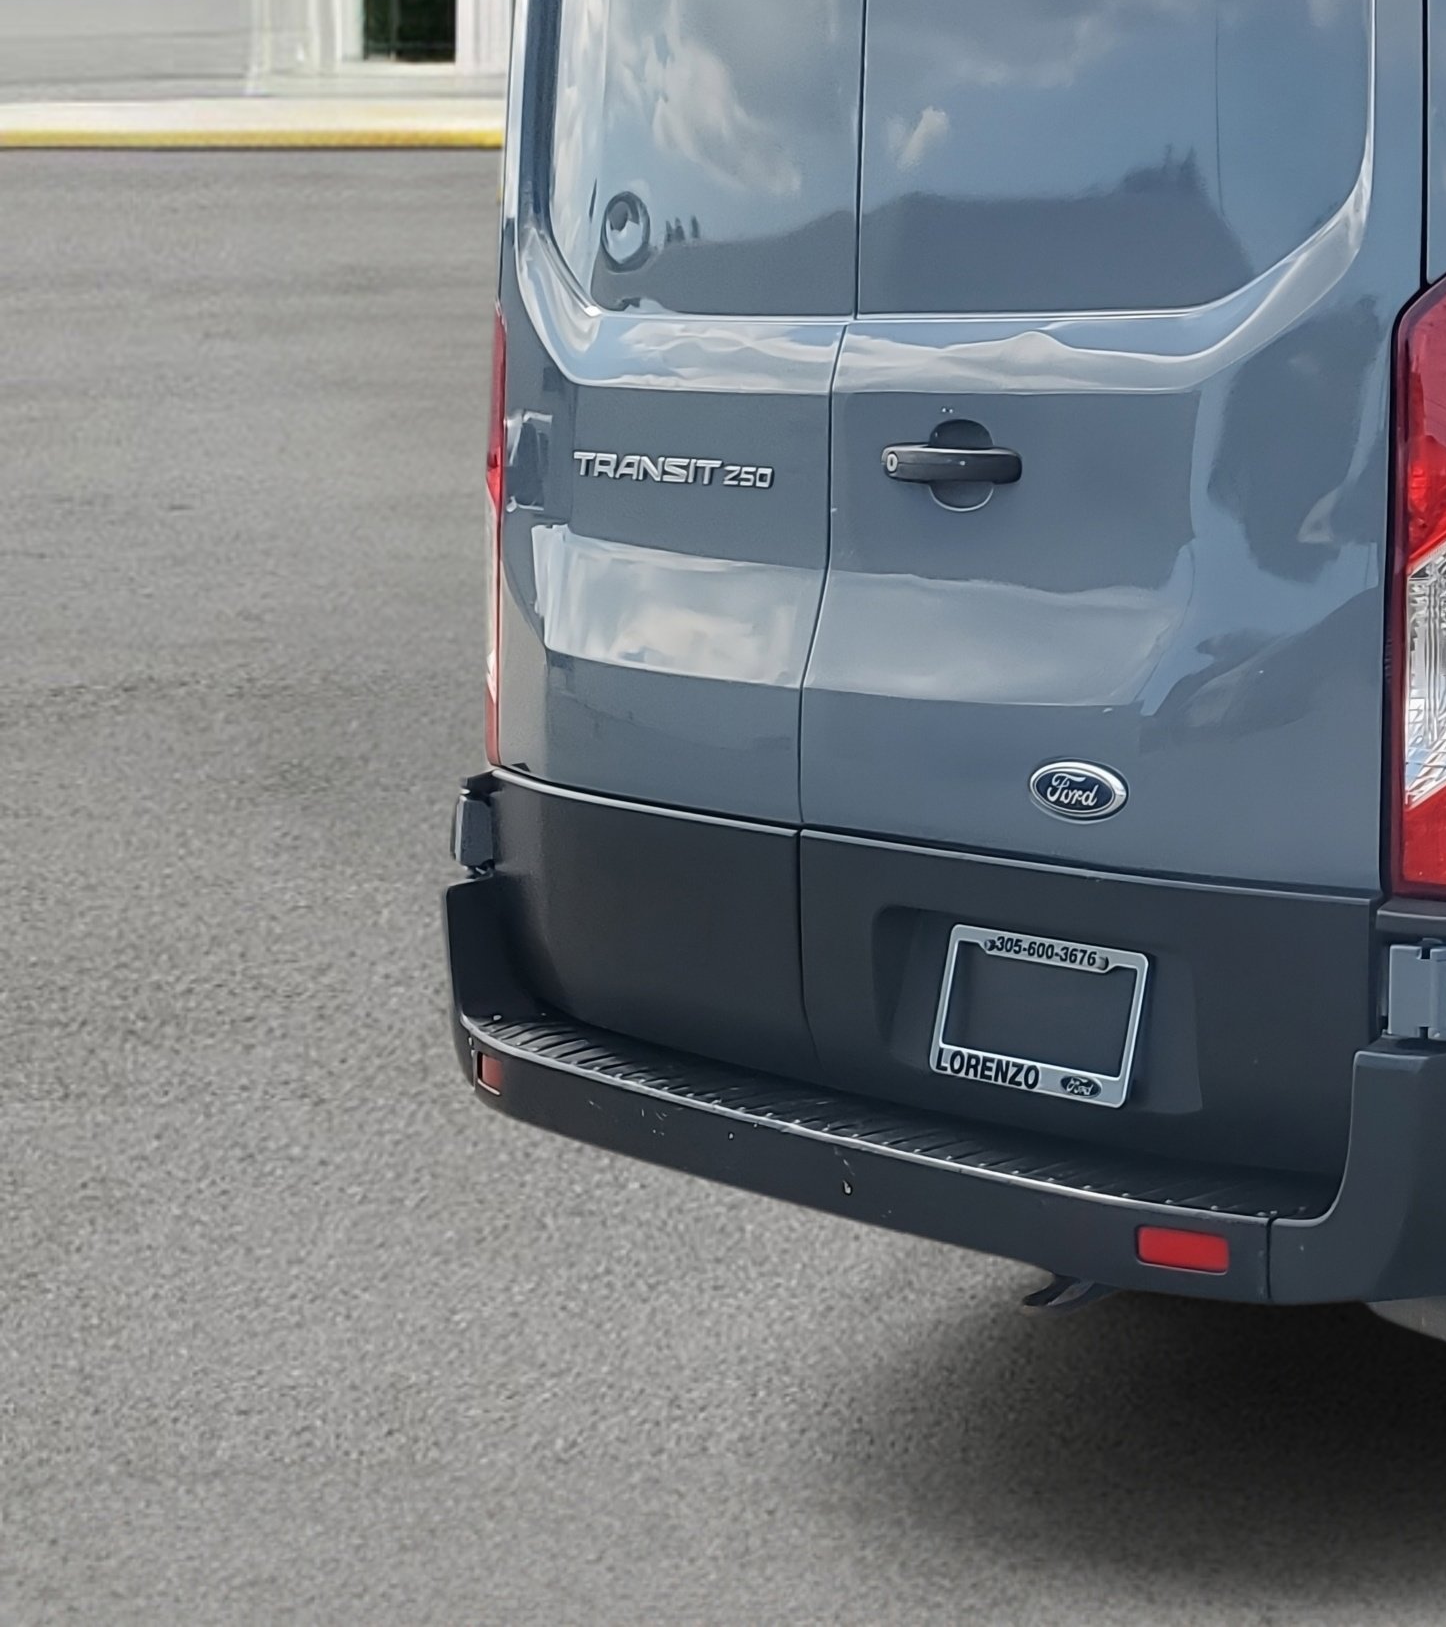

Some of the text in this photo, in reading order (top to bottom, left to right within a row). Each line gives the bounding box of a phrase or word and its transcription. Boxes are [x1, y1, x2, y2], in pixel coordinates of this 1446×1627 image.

[573, 451, 774, 489] TRANSIT 250
[1046, 772, 1099, 807] Ford
[996, 935, 1098, 967] 305-600-3676
[935, 1047, 1094, 1097] LORENZO Ford
